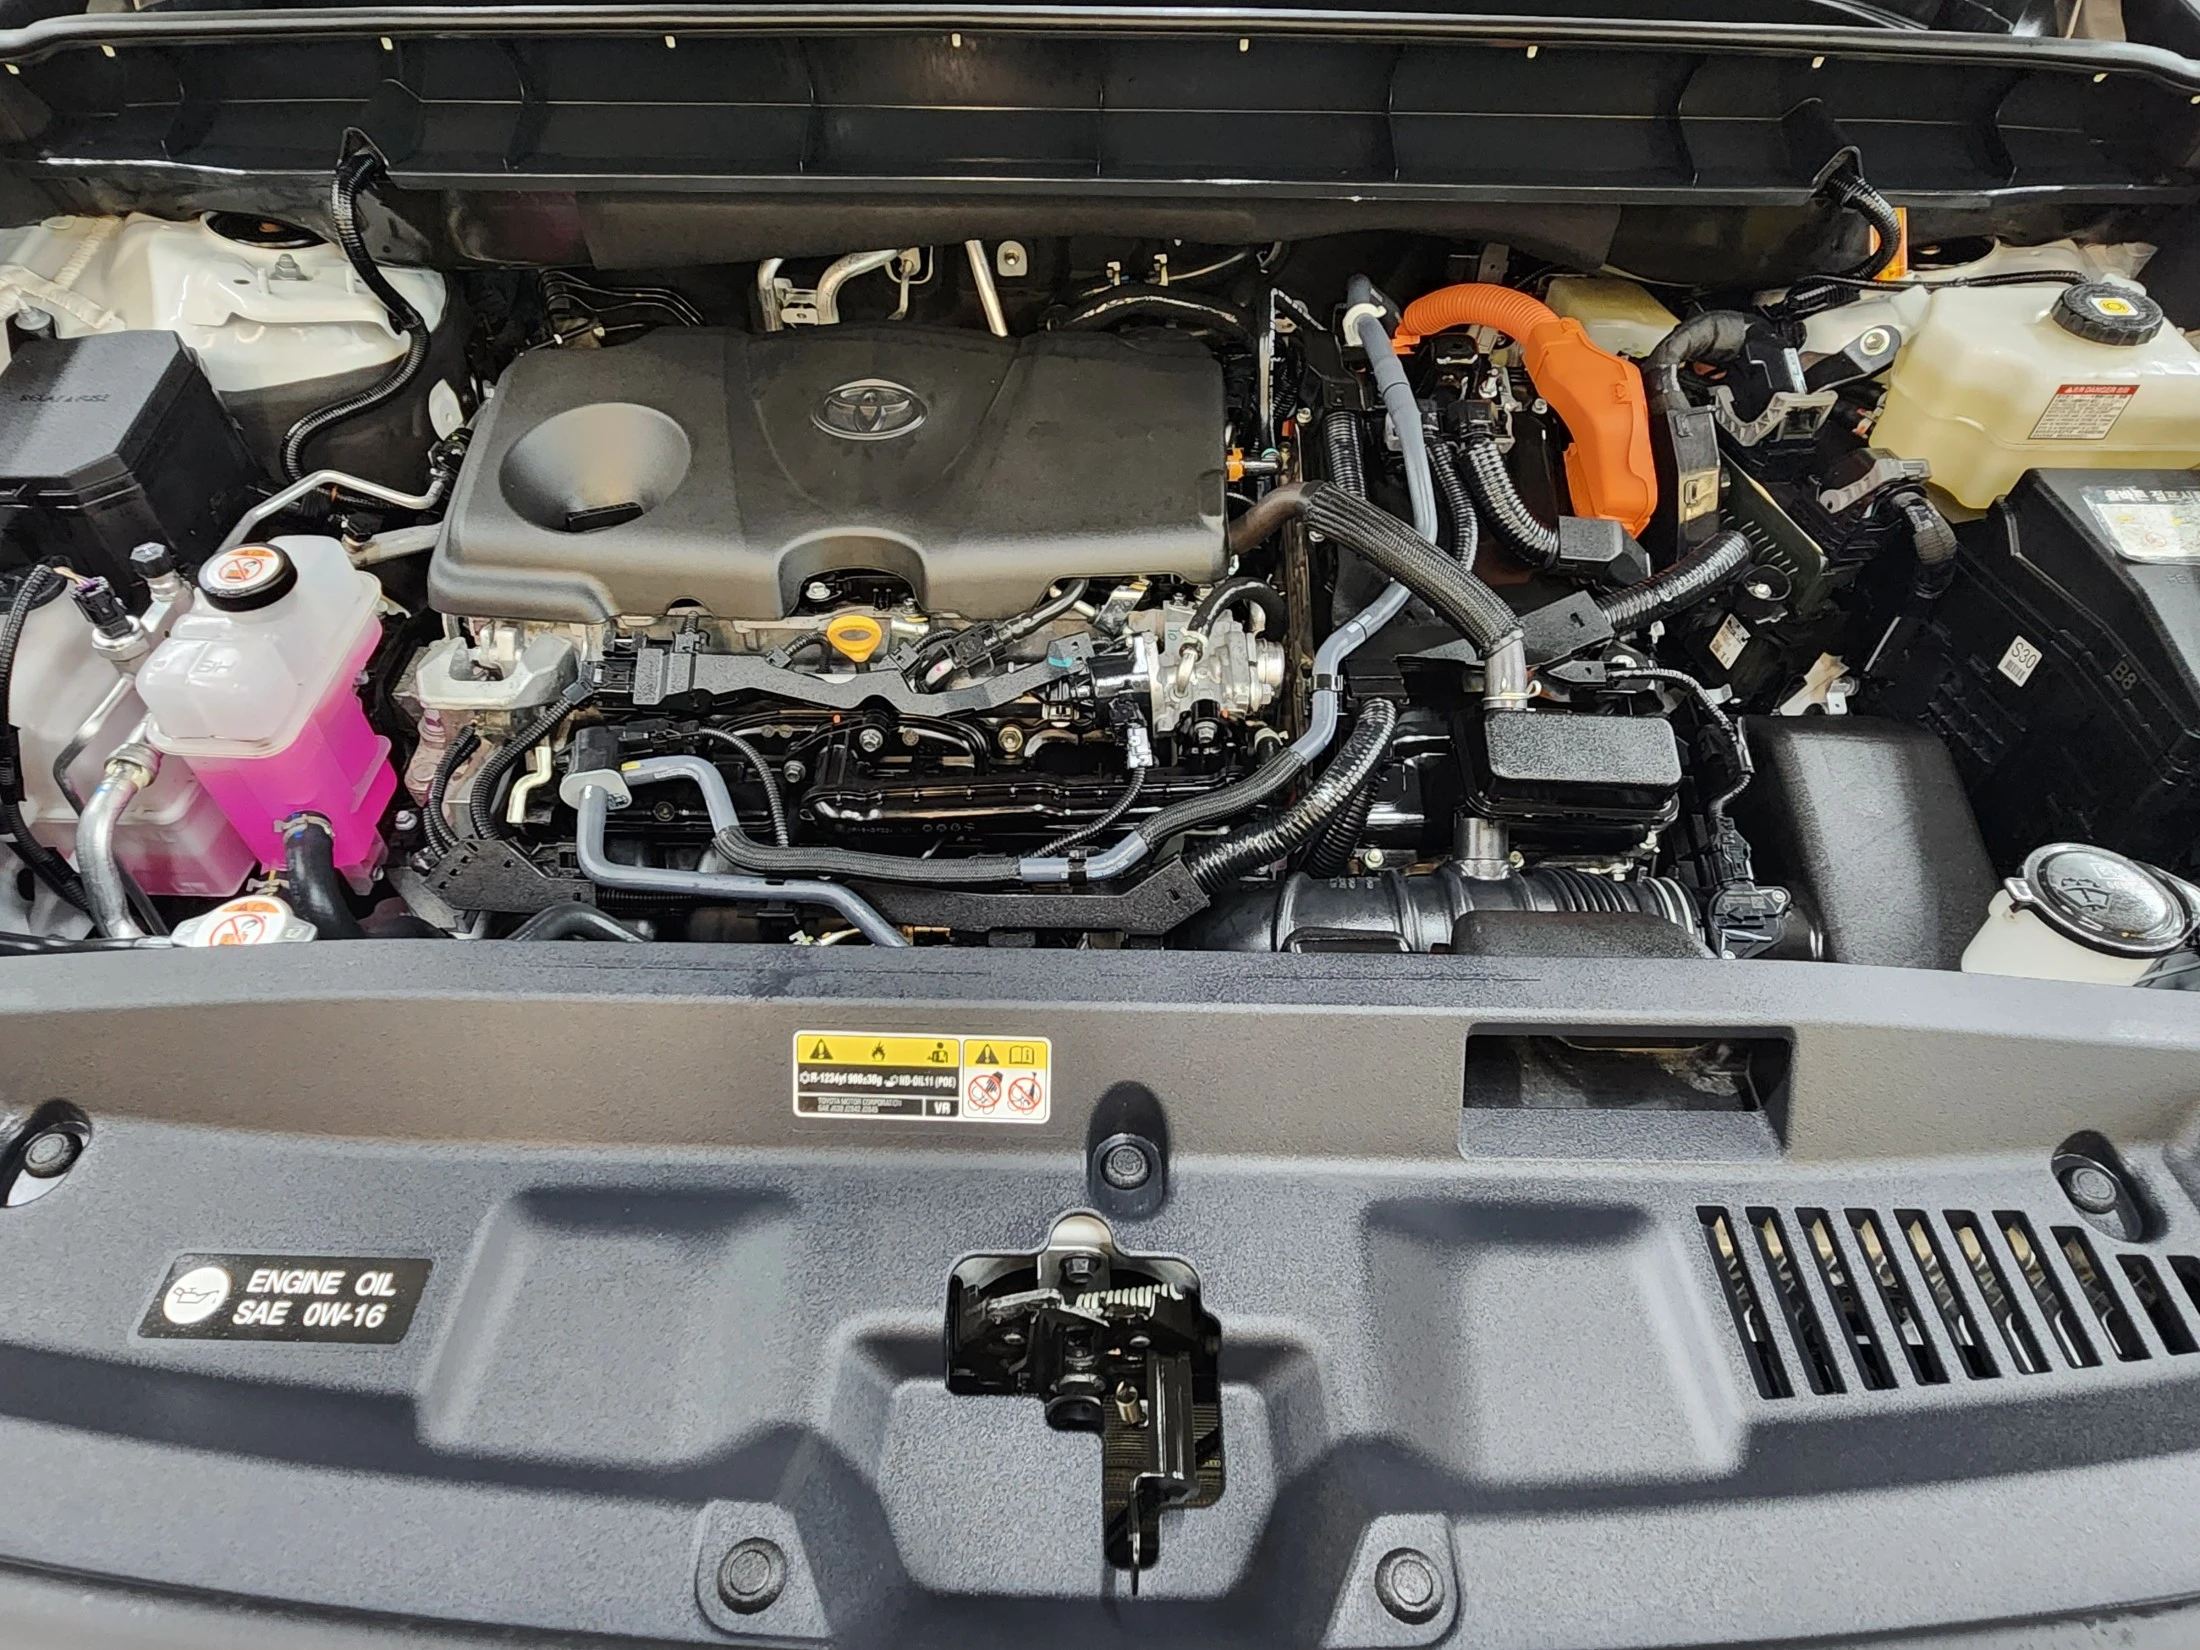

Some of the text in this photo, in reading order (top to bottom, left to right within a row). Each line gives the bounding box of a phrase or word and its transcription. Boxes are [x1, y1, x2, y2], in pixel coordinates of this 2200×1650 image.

[2103, 488, 2150, 502] 올바른
[2011, 642, 2037, 669] S30
[2111, 660, 2138, 690] B8
[810, 1071, 847, 1086] R-1234yf
[899, 1074, 934, 1087] ND-OIL11
[935, 1075, 957, 1089] (POE)
[818, 1097, 902, 1107] TOYOTA MOTOR CORPORATION
[818, 1104, 829, 1112] SAE
[933, 1101, 951, 1115] VR
[246, 1268, 397, 1297] ENGINE OIL
[232, 1300, 388, 1328] SAE 0W-16
